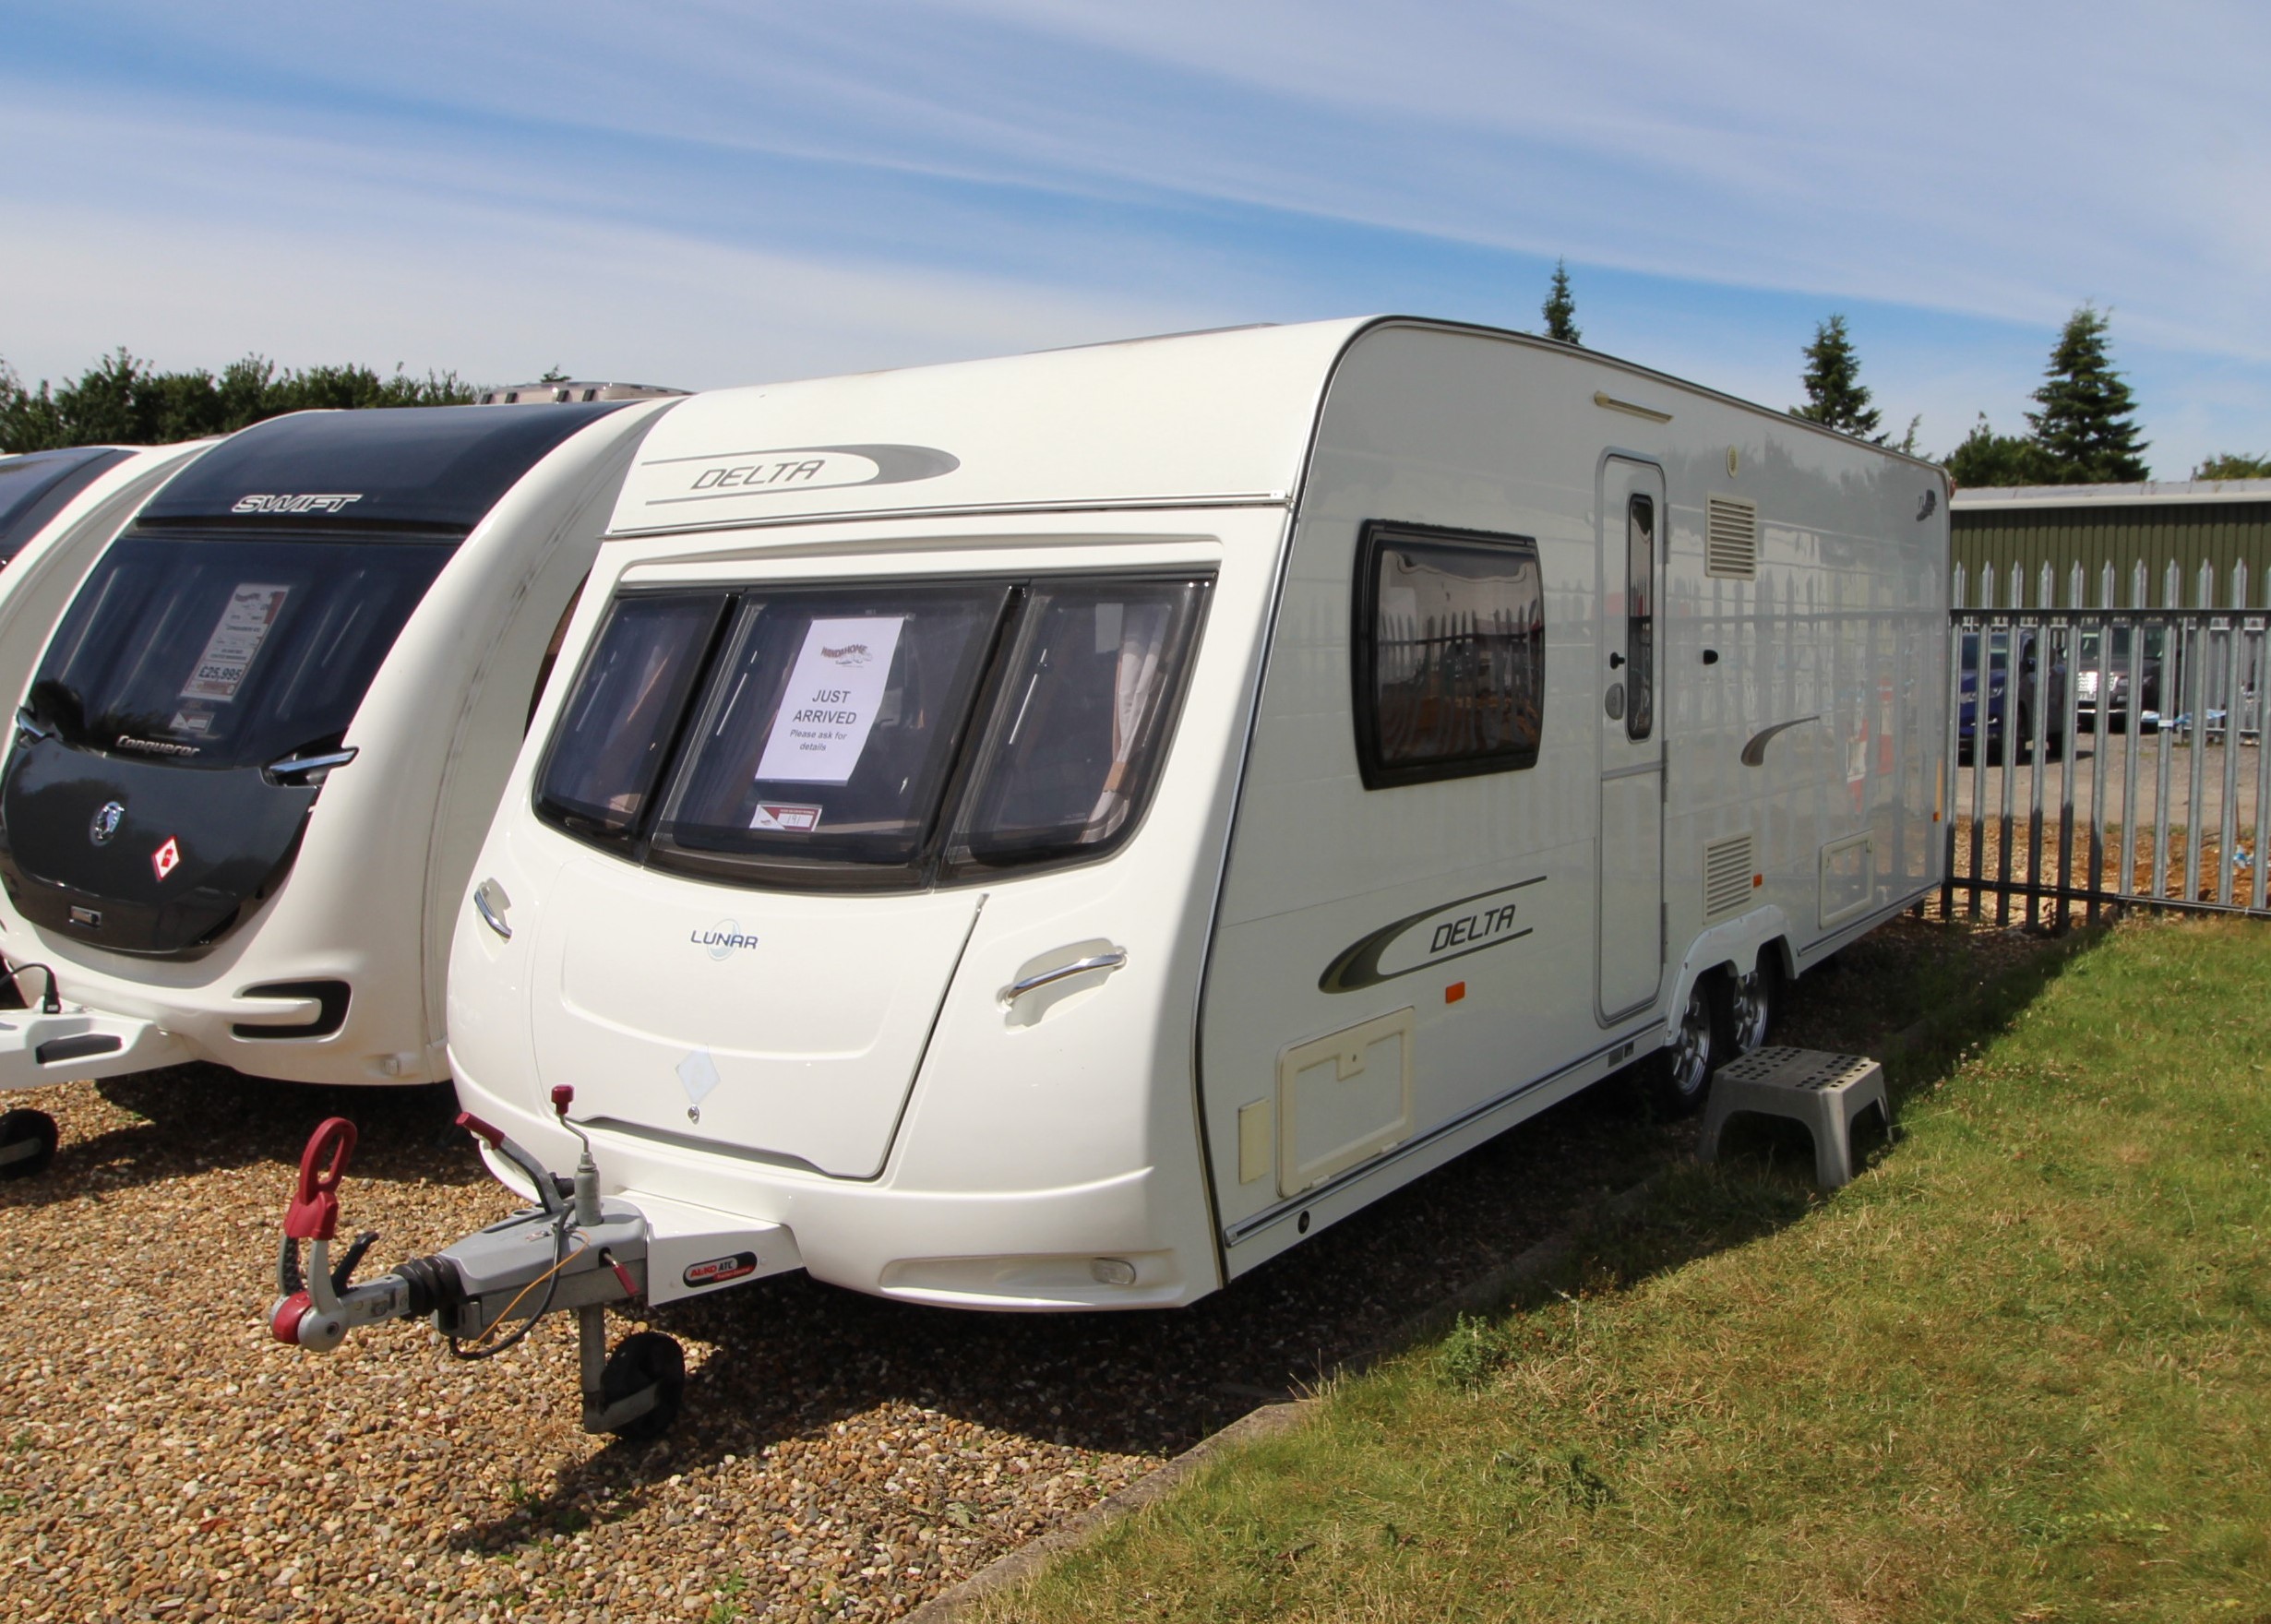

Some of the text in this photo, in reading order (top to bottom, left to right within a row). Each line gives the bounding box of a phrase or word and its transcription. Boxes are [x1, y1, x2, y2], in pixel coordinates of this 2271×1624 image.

[690, 460, 826, 490] DELTA
[231, 494, 364, 513] SWIFT
[198, 665, 242, 682] £25,995
[812, 689, 851, 703] JUST
[792, 710, 857, 724] ARRIVED
[790, 729, 848, 740] Please ask for
[116, 734, 201, 757] Conqueror
[799, 742, 827, 751] details
[1428, 903, 1516, 954] DELTA
[690, 929, 759, 949] LUNAR
[718, 1260, 734, 1272] ATC
